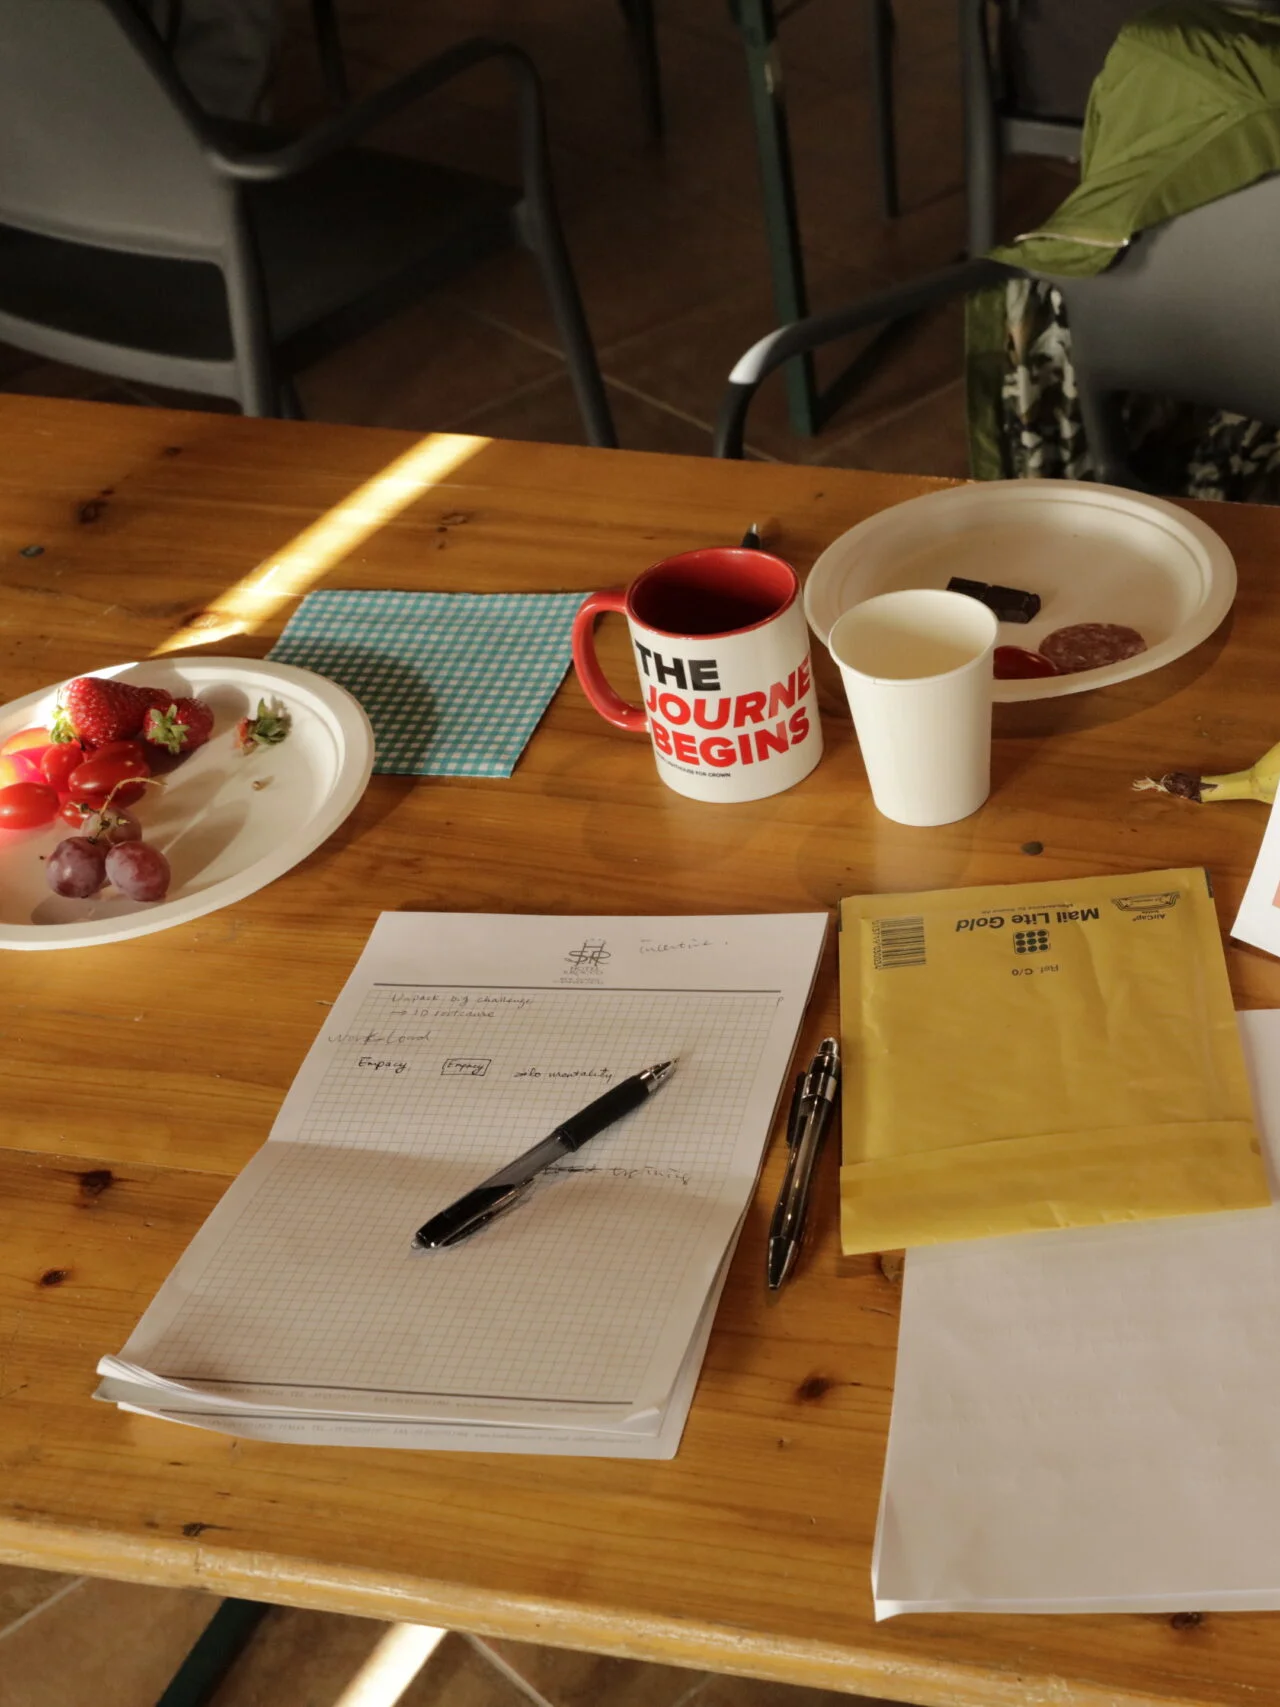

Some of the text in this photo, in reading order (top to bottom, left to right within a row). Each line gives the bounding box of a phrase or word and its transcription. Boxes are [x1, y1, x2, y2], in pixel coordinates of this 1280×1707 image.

[634, 639, 721, 691] THE
[650, 706, 810, 768] BEGINS
[955, 907, 1100, 932] Mail Lite Gold
